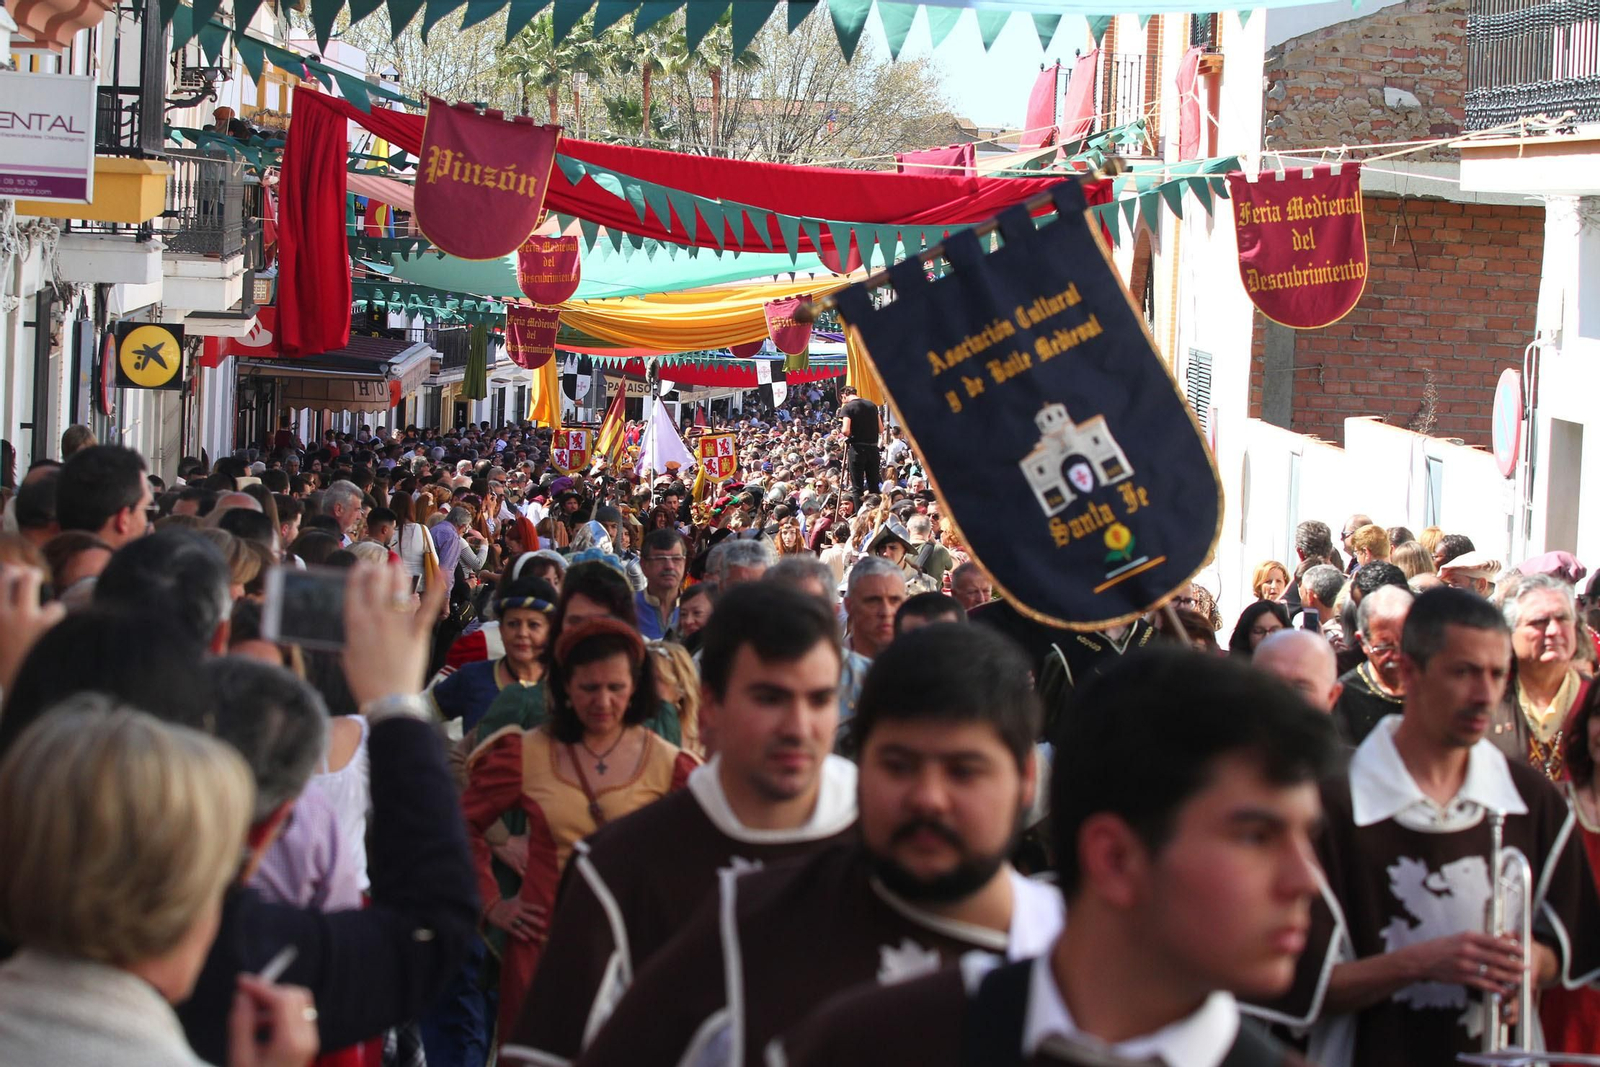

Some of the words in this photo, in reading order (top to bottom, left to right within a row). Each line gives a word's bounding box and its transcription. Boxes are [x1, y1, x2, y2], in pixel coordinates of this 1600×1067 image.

[425, 145, 538, 198] Pinzón
[1238, 200, 1281, 227] Feria
[1286, 191, 1360, 221] Medieval
[541, 241, 578, 254] Medieval
[1291, 226, 1317, 252] del
[543, 256, 555, 267] del
[520, 272, 578, 284] Descubrimiento
[1246, 258, 1365, 292] Descubrimiento
[508, 315, 526, 326] Feria
[527, 317, 558, 329] Medieval
[527, 329, 537, 340] del
[927, 318, 1016, 376] Asociación
[1015, 281, 1082, 329] Cultural
[945, 390, 963, 413] y
[961, 376, 985, 398] de
[986, 350, 1033, 384] Baile
[1034, 313, 1103, 362] Medieval
[607, 381, 652, 393] PAAISO
[1048, 501, 1116, 548] Santa
[1117, 481, 1149, 514] Fe
